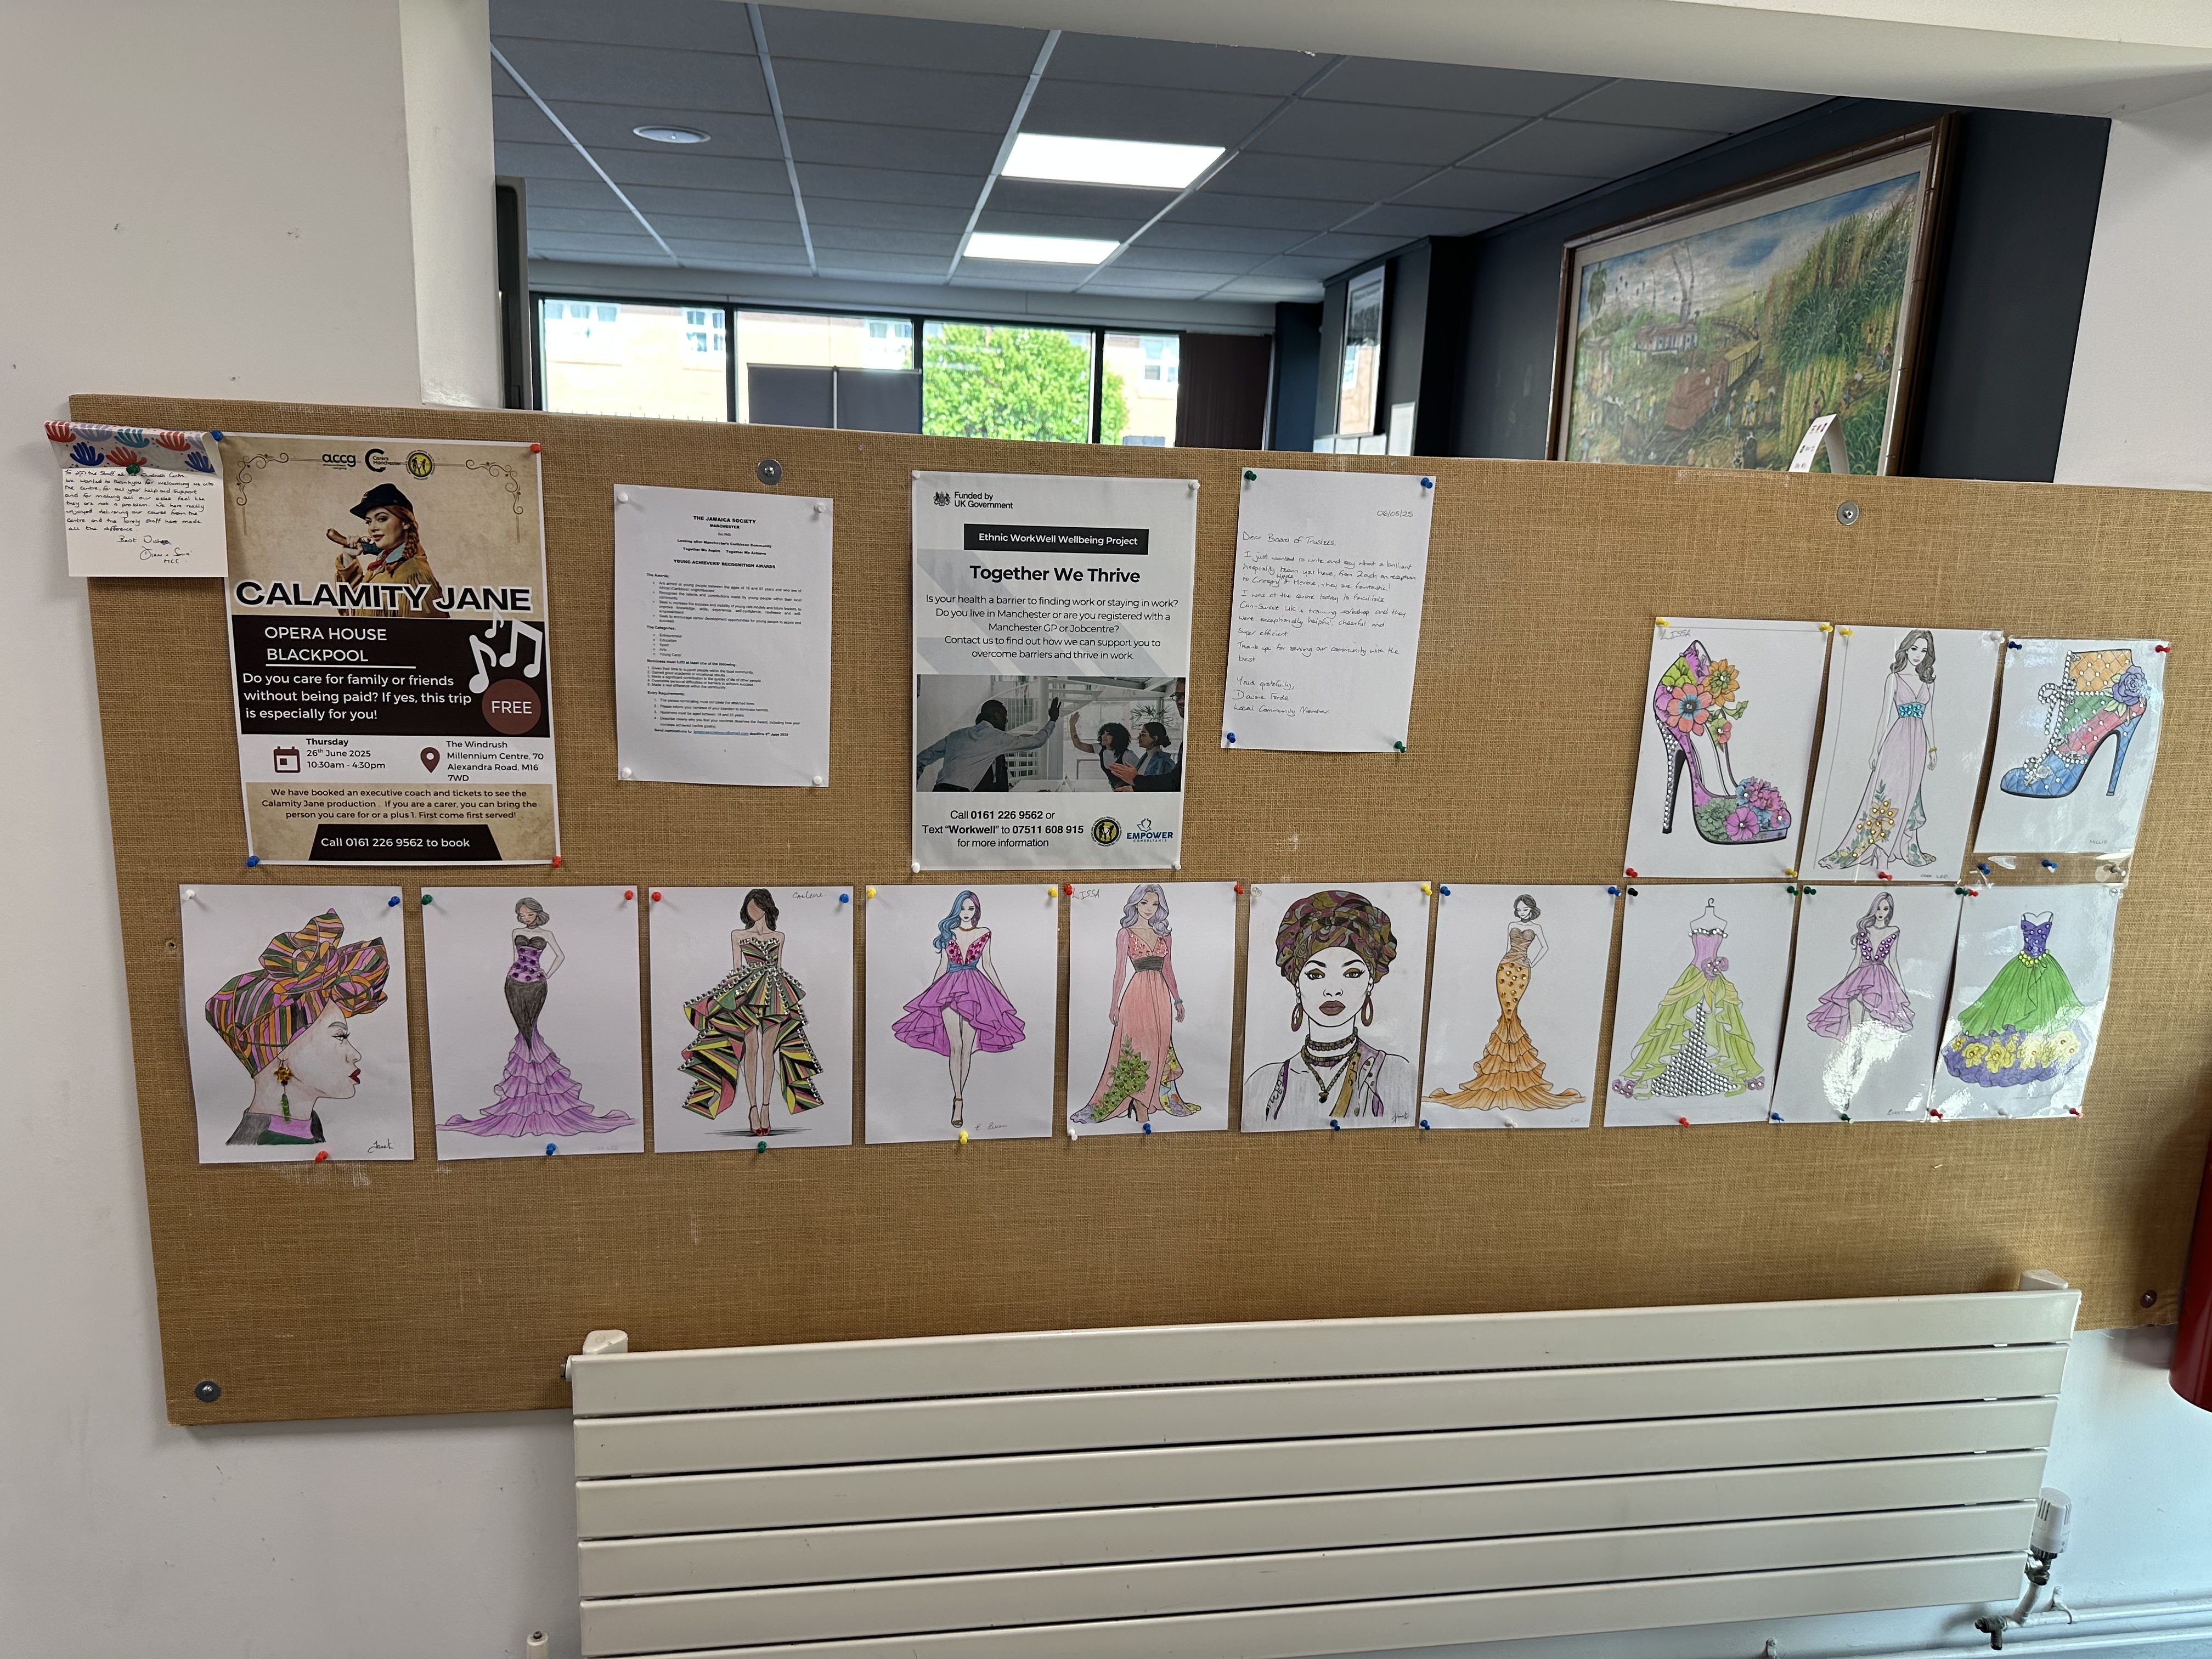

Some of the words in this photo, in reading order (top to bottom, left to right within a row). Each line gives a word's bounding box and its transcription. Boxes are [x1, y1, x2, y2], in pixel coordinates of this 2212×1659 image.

[322, 454, 356, 467] accg
[954, 491, 983, 499] Funded
[984, 492, 994, 501] by
[968, 500, 1013, 509] Government
[979, 533, 1008, 541] Ethnic
[1010, 534, 1056, 543] WorkWell
[1058, 535, 1104, 546] Wellbeing
[1107, 537, 1137, 546] Project
[1243, 531, 1261, 540] Dear
[1268, 534, 1290, 543] Board
[970, 566, 1049, 583] Together
[1054, 567, 1083, 582] We
[1087, 568, 1141, 583] Thrive
[235, 582, 430, 609] CALAMITY
[435, 588, 531, 611] JANE
[935, 596, 956, 605] your
[958, 595, 986, 603] health
[997, 596, 1026, 605] barrier
[1039, 596, 1070, 607] finding
[1073, 598, 1094, 606] work
[1108, 599, 1139, 608] staying
[1152, 599, 1178, 607] work?
[936, 608, 949, 617] Do
[951, 610, 967, 618] you
[970, 609, 985, 617] live
[998, 610, 1051, 619] Manchester
[1079, 613, 1096, 621] you
[1098, 612, 1142, 622] registered
[1144, 612, 1163, 620] with
[265, 627, 324, 640] OPERA
[329, 628, 387, 640] HOUSE
[267, 648, 368, 661] BLACKPOOL
[243, 673, 262, 683] Do
[266, 675, 289, 686] you
[326, 674, 344, 684] for
[347, 674, 388, 687] family
[409, 675, 454, 686] friends
[244, 690, 297, 701] without
[302, 691, 338, 704] being
[343, 691, 378, 704] paid?
[382, 691, 391, 702] If
[394, 694, 417, 704] yes,
[421, 692, 445, 703] this
[448, 692, 472, 706] trip
[492, 701, 532, 714] FREE
[246, 708, 256, 718] is
[259, 708, 325, 721] especially
[329, 708, 347, 719] for
[350, 709, 377, 721] you!
[306, 738, 348, 747] Thursday
[352, 761, 385, 770] 4:30pm
[951, 810, 968, 820] Call
[971, 810, 994, 820] 0161
[998, 810, 1016, 820] 226
[1019, 810, 1043, 819] 9562
[922, 826, 943, 834] Text
[1012, 826, 1041, 834] 07511
[1046, 826, 1063, 834] 608
[1066, 826, 1084, 834] 915
[1127, 832, 1173, 840] EMPOWER
[321, 838, 342, 847] Call
[346, 838, 369, 847] 0161
[373, 838, 393, 847] 226
[396, 838, 423, 847] 9562
[442, 838, 470, 847] book
[957, 838, 970, 847] for
[998, 838, 1048, 847] information
